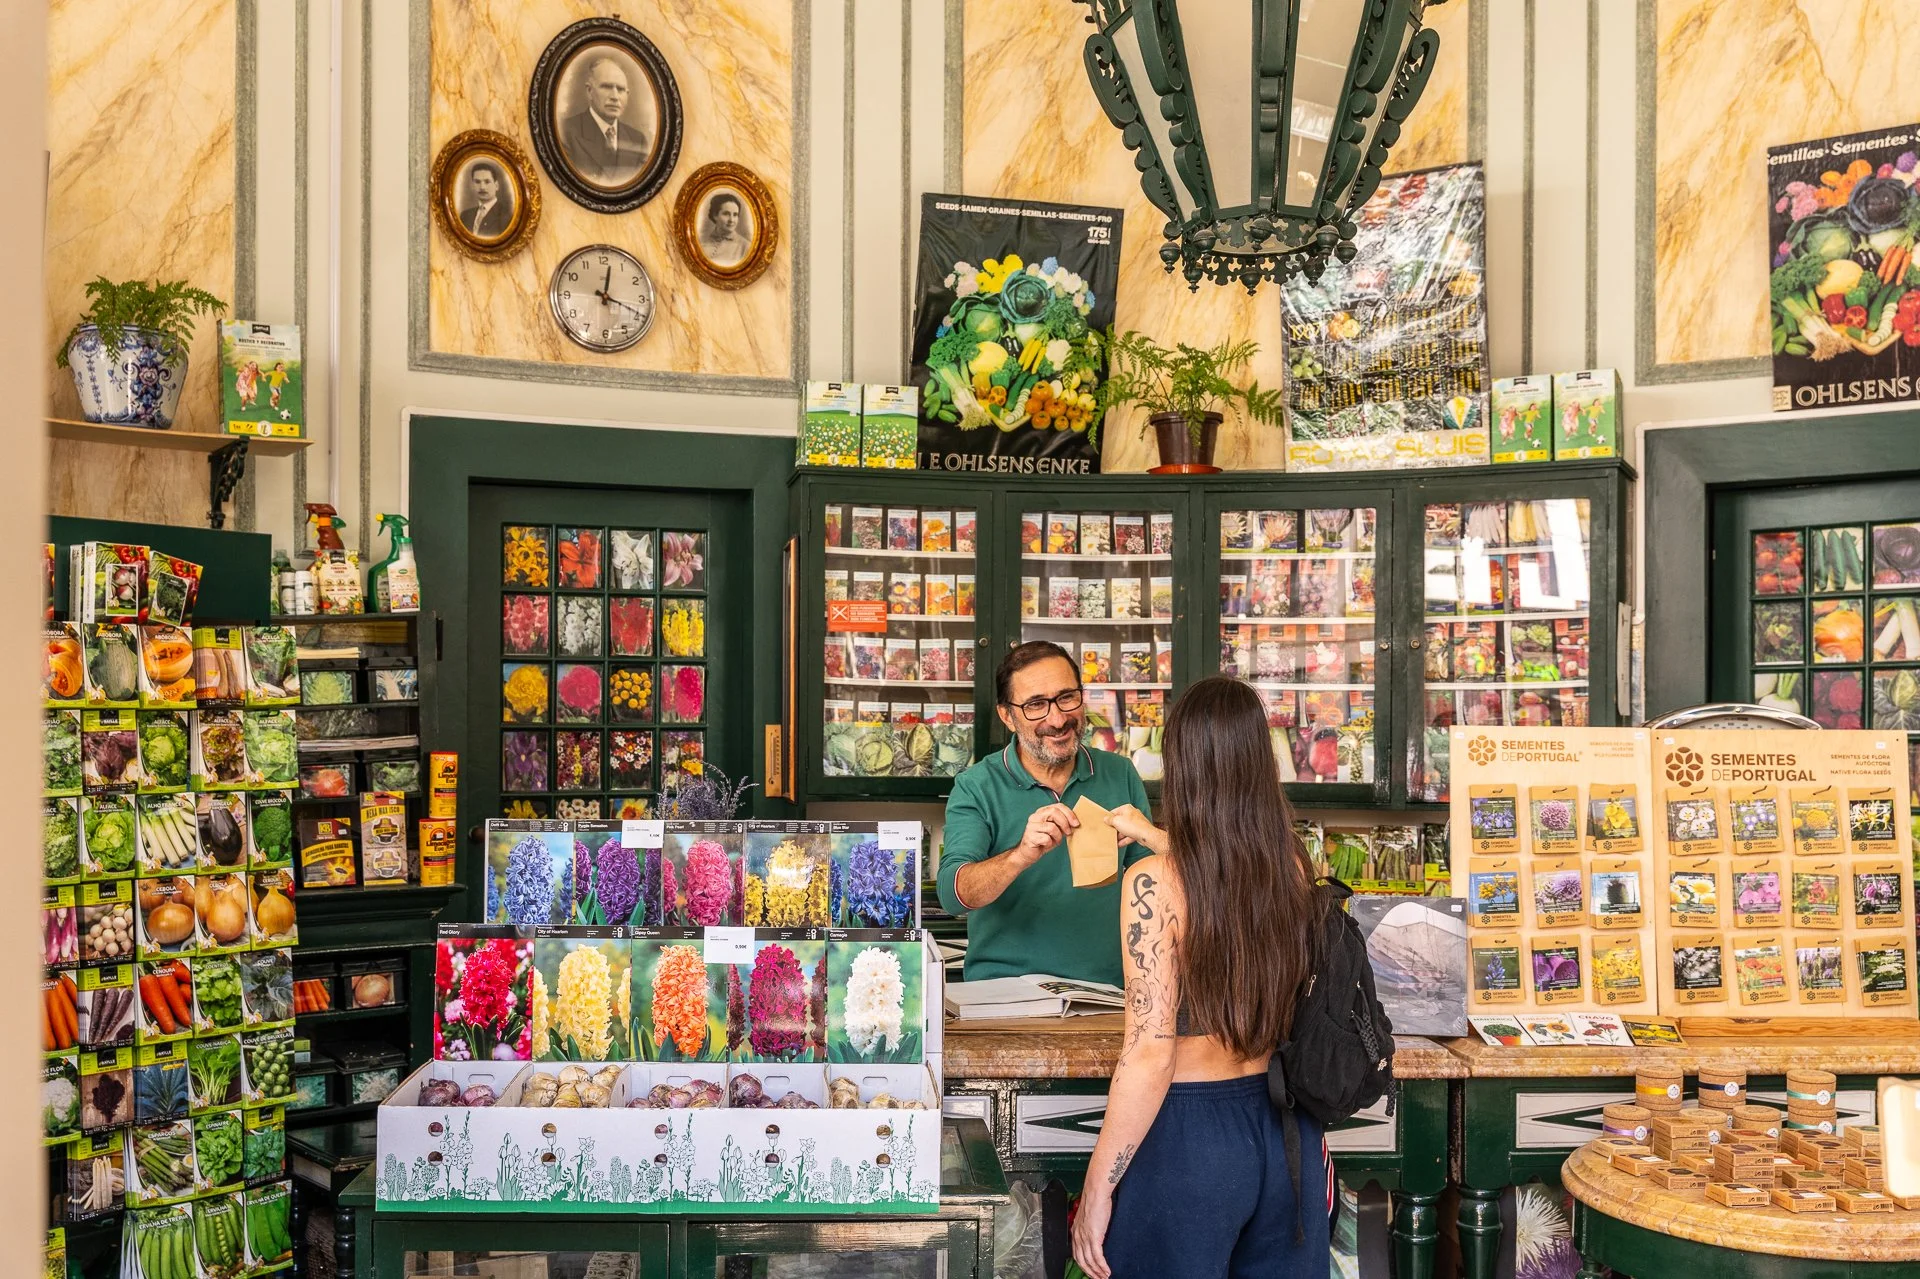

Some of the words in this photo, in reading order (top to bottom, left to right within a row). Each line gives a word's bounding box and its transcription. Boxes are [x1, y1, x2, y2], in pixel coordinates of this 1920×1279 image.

[1830, 133, 1909, 157] Sementes
[935, 201, 960, 212] SEEDS
[961, 204, 988, 215] SAMEN
[988, 206, 1021, 217] GRAINES
[1021, 208, 1058, 219] SEMILLAS
[1058, 211, 1097, 222] SEMENTES
[581, 260, 590, 270] 11
[598, 256, 609, 266] 12
[567, 272, 579, 282] 10
[632, 276, 640, 286] 2
[563, 290, 571, 300] 9
[638, 294, 646, 304] 3
[569, 308, 577, 319] 8
[583, 323, 591, 333] 7
[621, 324, 628, 335] 5
[601, 329, 610, 339] 6
[1795, 375, 1912, 407] OHLSENS
[944, 452, 1035, 475] OHLSENS
[1501, 740, 1565, 751] SEMENTES
[1710, 753, 1797, 767] SEMENTES
[439, 928, 449, 936] Red
[537, 928, 547, 936] City
[1578, 1014, 1615, 1022] CRAVO
